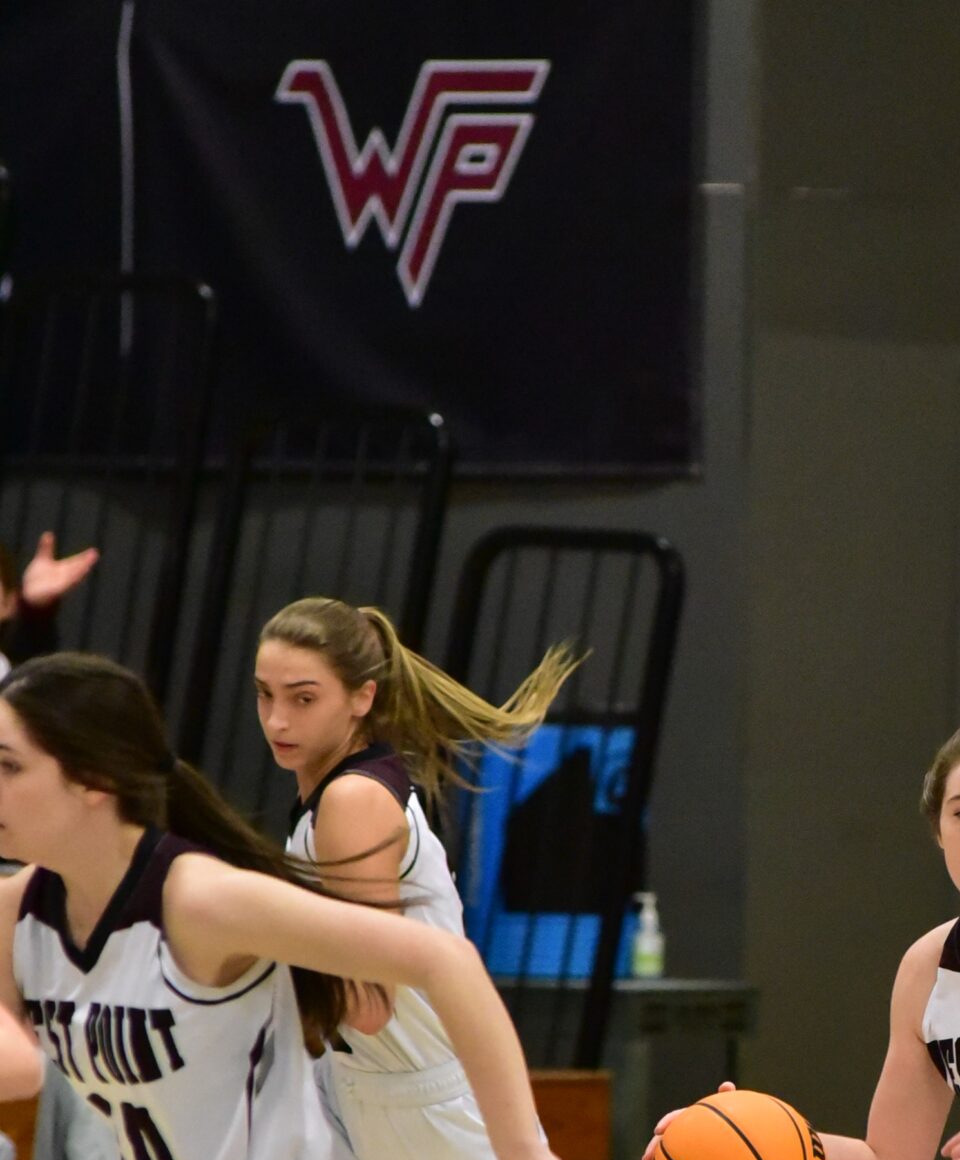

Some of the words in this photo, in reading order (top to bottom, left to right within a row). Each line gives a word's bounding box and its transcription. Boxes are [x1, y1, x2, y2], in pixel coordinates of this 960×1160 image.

[275, 59, 551, 308] WP
[23, 1000, 85, 1083] ST
[84, 1003, 185, 1084] POINT
